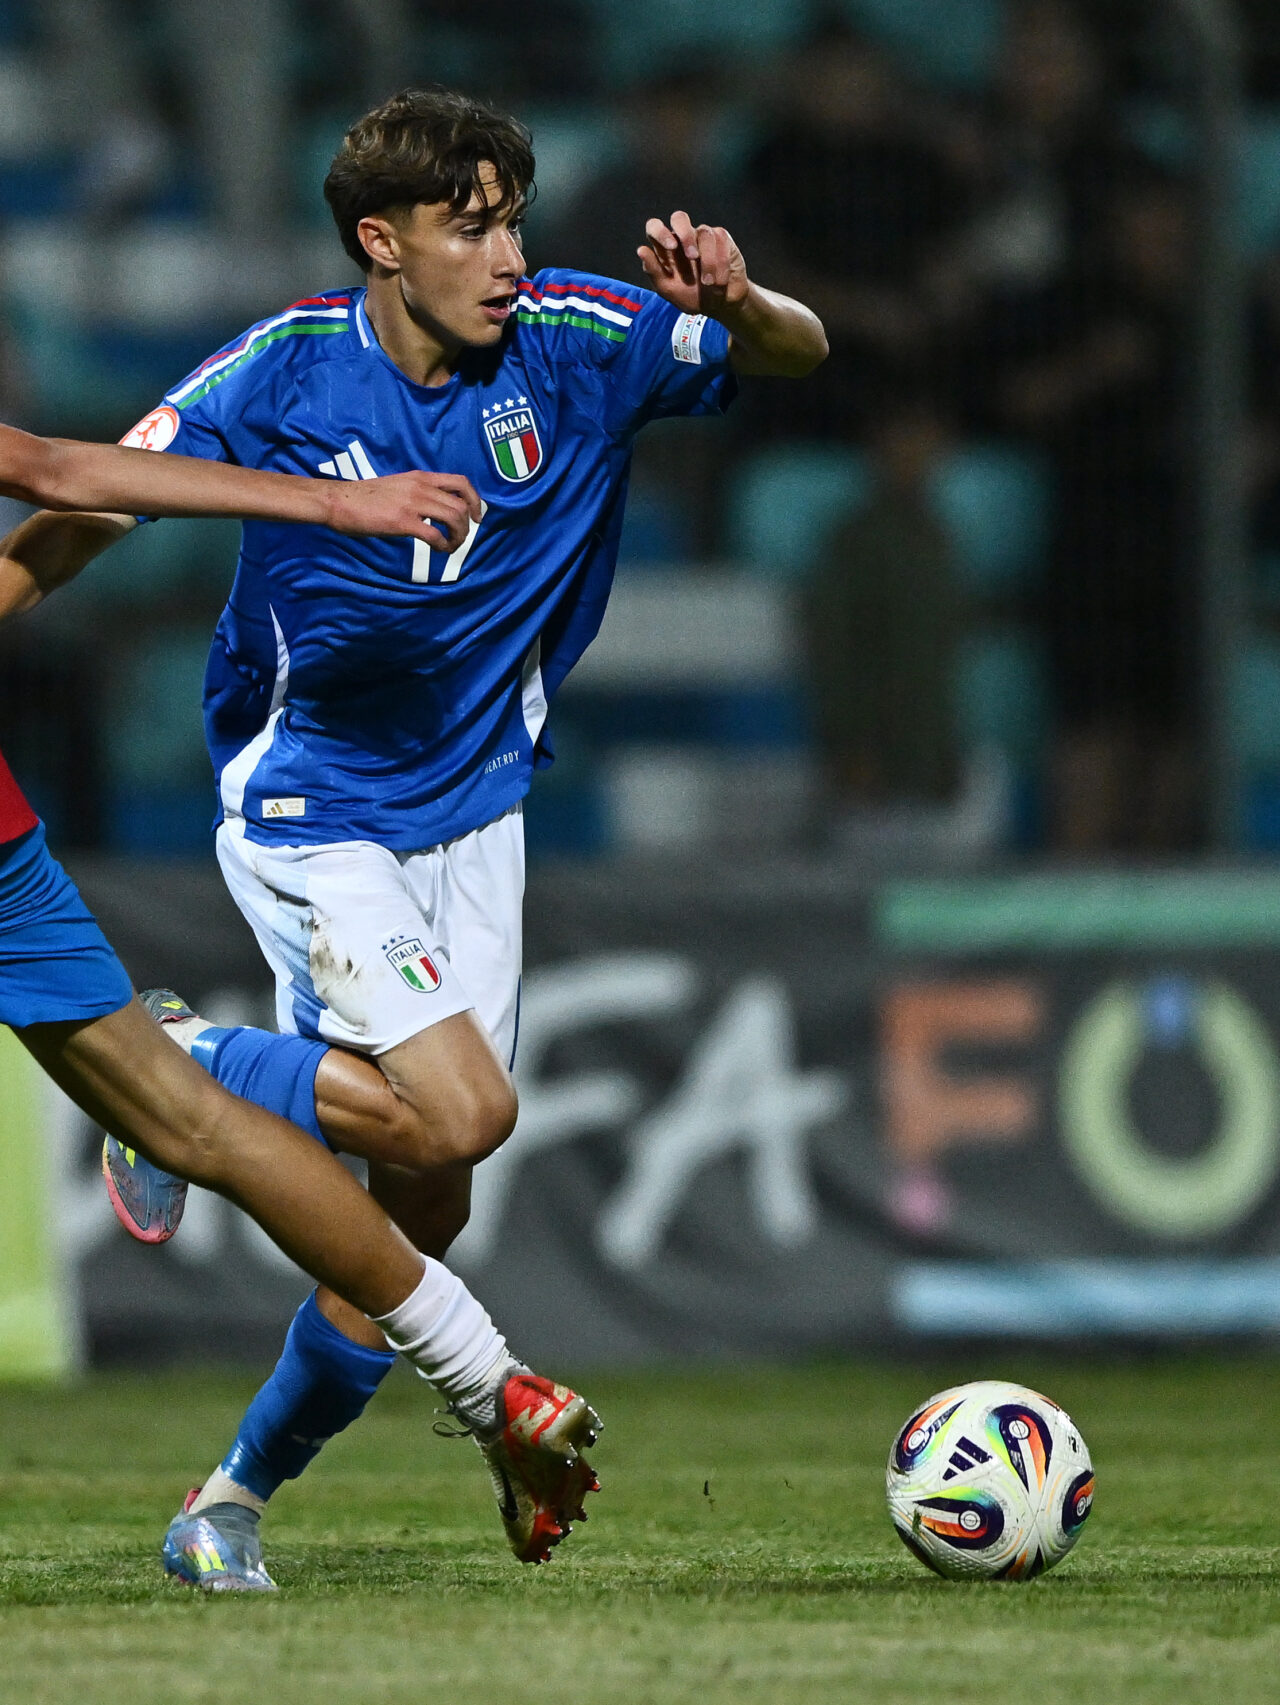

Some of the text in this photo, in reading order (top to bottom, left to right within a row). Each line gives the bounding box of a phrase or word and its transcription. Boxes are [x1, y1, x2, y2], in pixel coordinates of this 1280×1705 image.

[681, 314, 697, 360] FOUNDAT
[489, 413, 531, 438] ITALIA
[390, 944, 422, 964] ITALIA
